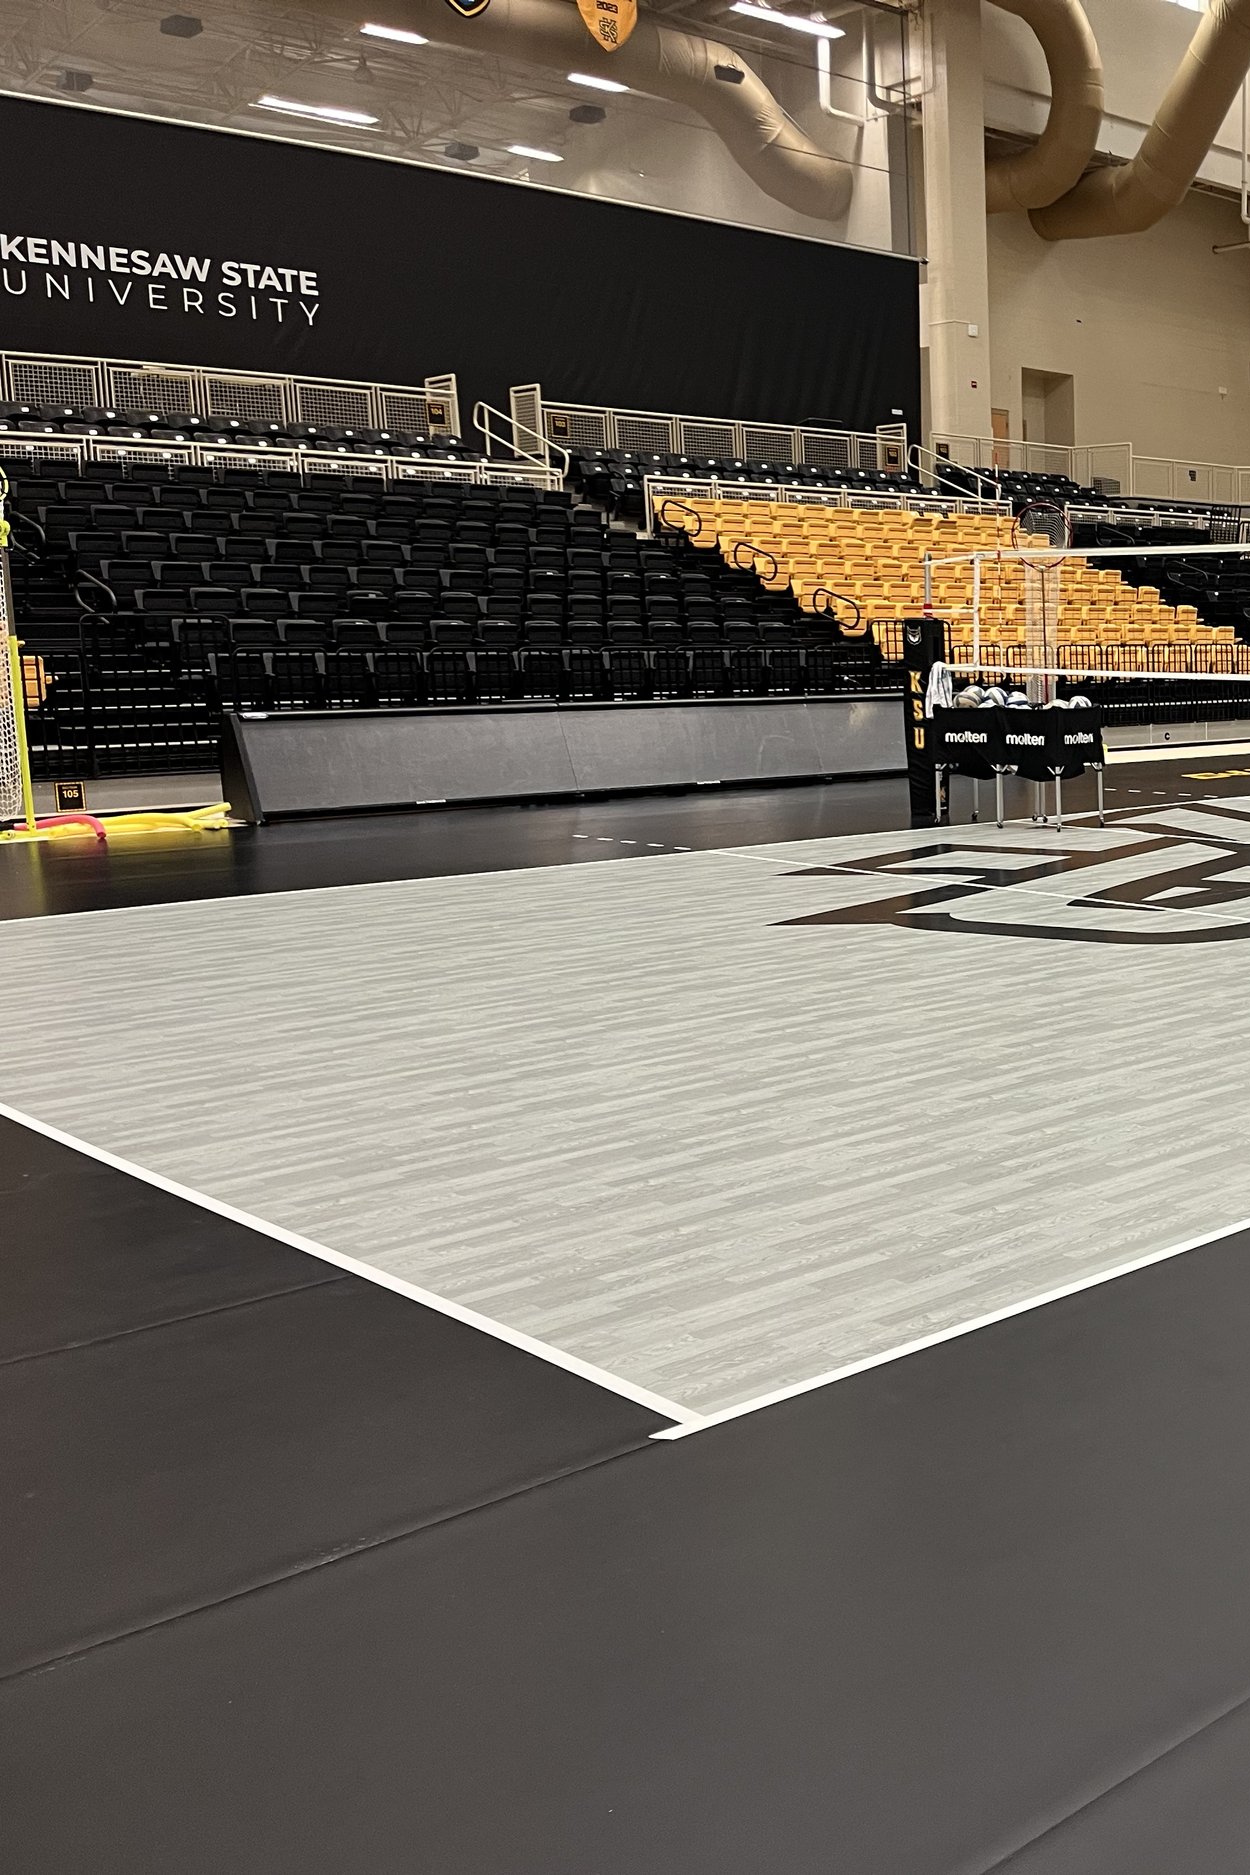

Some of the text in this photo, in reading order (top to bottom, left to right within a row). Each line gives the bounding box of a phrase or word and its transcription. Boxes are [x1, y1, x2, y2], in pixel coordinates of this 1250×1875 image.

[0, 234, 319, 296] KENNESAW STATE
[3, 268, 320, 326] UNIVERSITY
[945, 731, 987, 743] molten
[1006, 733, 1045, 746] molten
[1064, 732, 1094, 745] molten
[62, 790, 79, 798] 105
